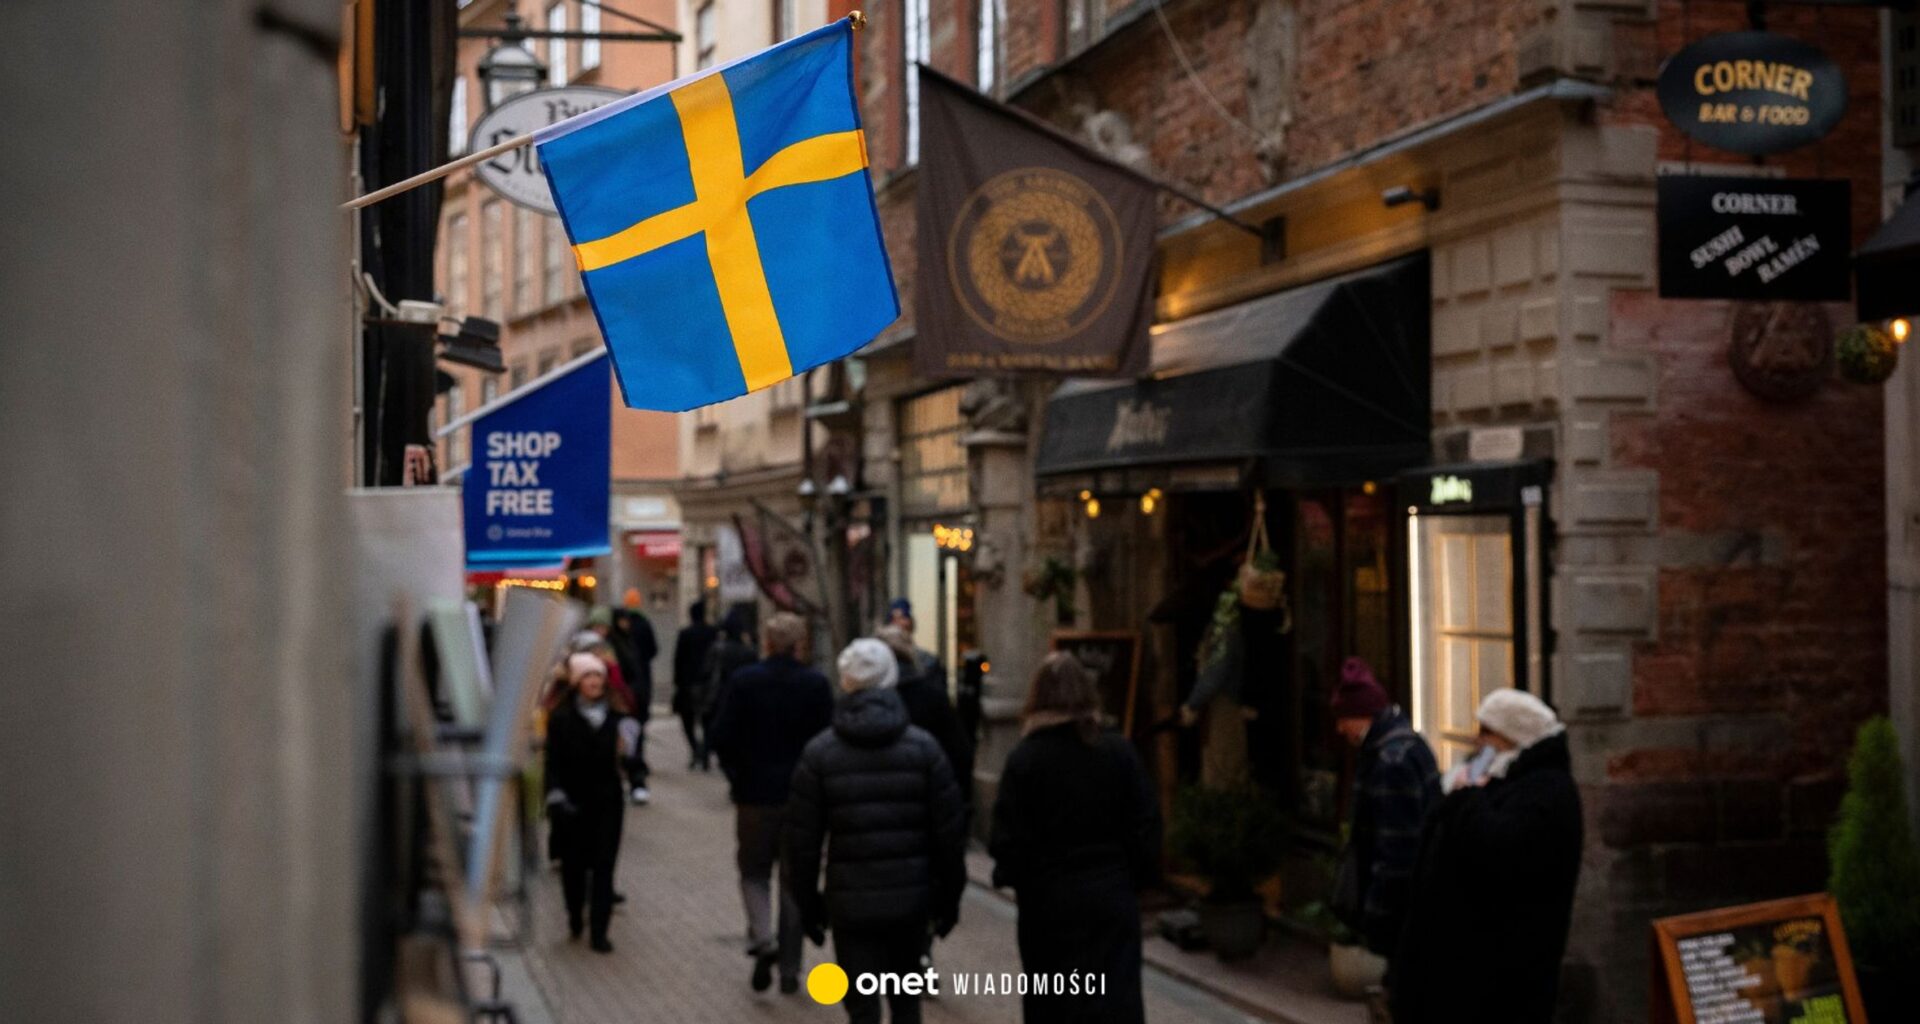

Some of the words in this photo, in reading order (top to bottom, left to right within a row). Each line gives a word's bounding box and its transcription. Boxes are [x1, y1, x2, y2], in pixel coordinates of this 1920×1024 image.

[1695, 60, 1813, 99] CORNER
[1698, 103, 1737, 123] BAR
[1758, 105, 1810, 125] FOOD
[1711, 192, 1798, 215] CORNER
[1690, 225, 1744, 269] SUSHI
[1724, 235, 1779, 276] BOWL
[486, 431, 562, 458] SHOP
[486, 460, 540, 487] TAX
[486, 489, 554, 516] FREE
